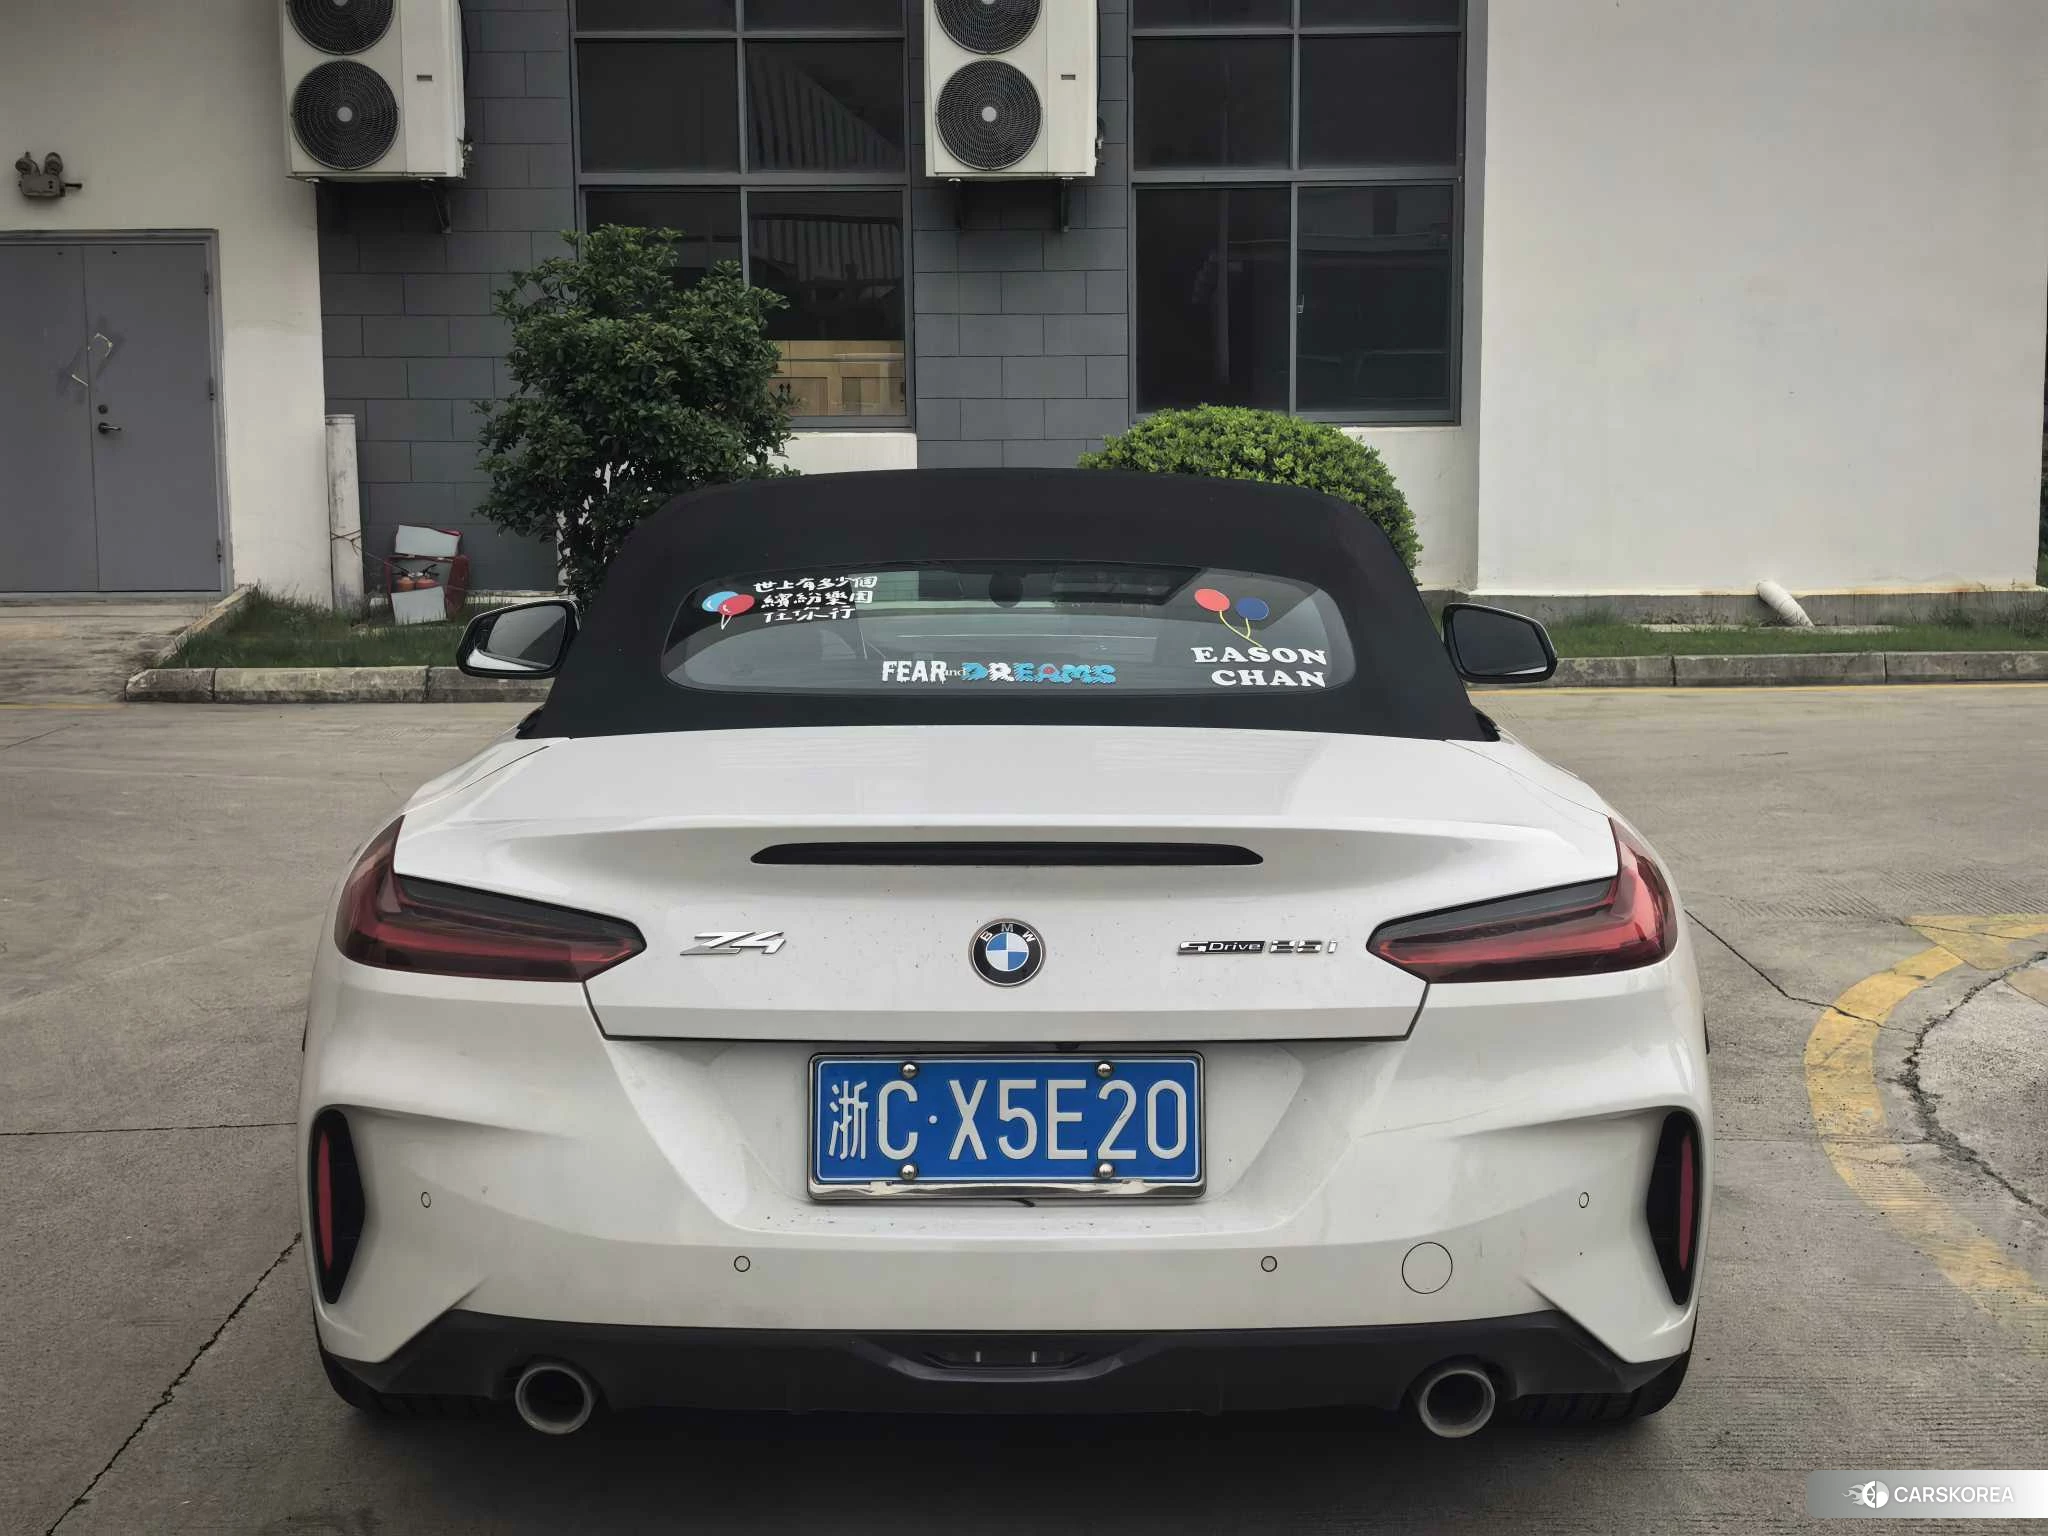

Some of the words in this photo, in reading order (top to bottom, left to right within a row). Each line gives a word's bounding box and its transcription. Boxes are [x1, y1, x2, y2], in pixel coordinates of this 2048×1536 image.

[1190, 646, 1328, 665] EASON
[881, 660, 947, 685] FEAR
[961, 662, 1117, 684] DREAMS
[1211, 669, 1326, 688] CHAN
[980, 923, 1036, 943] BMW
[679, 931, 785, 956] Z4
